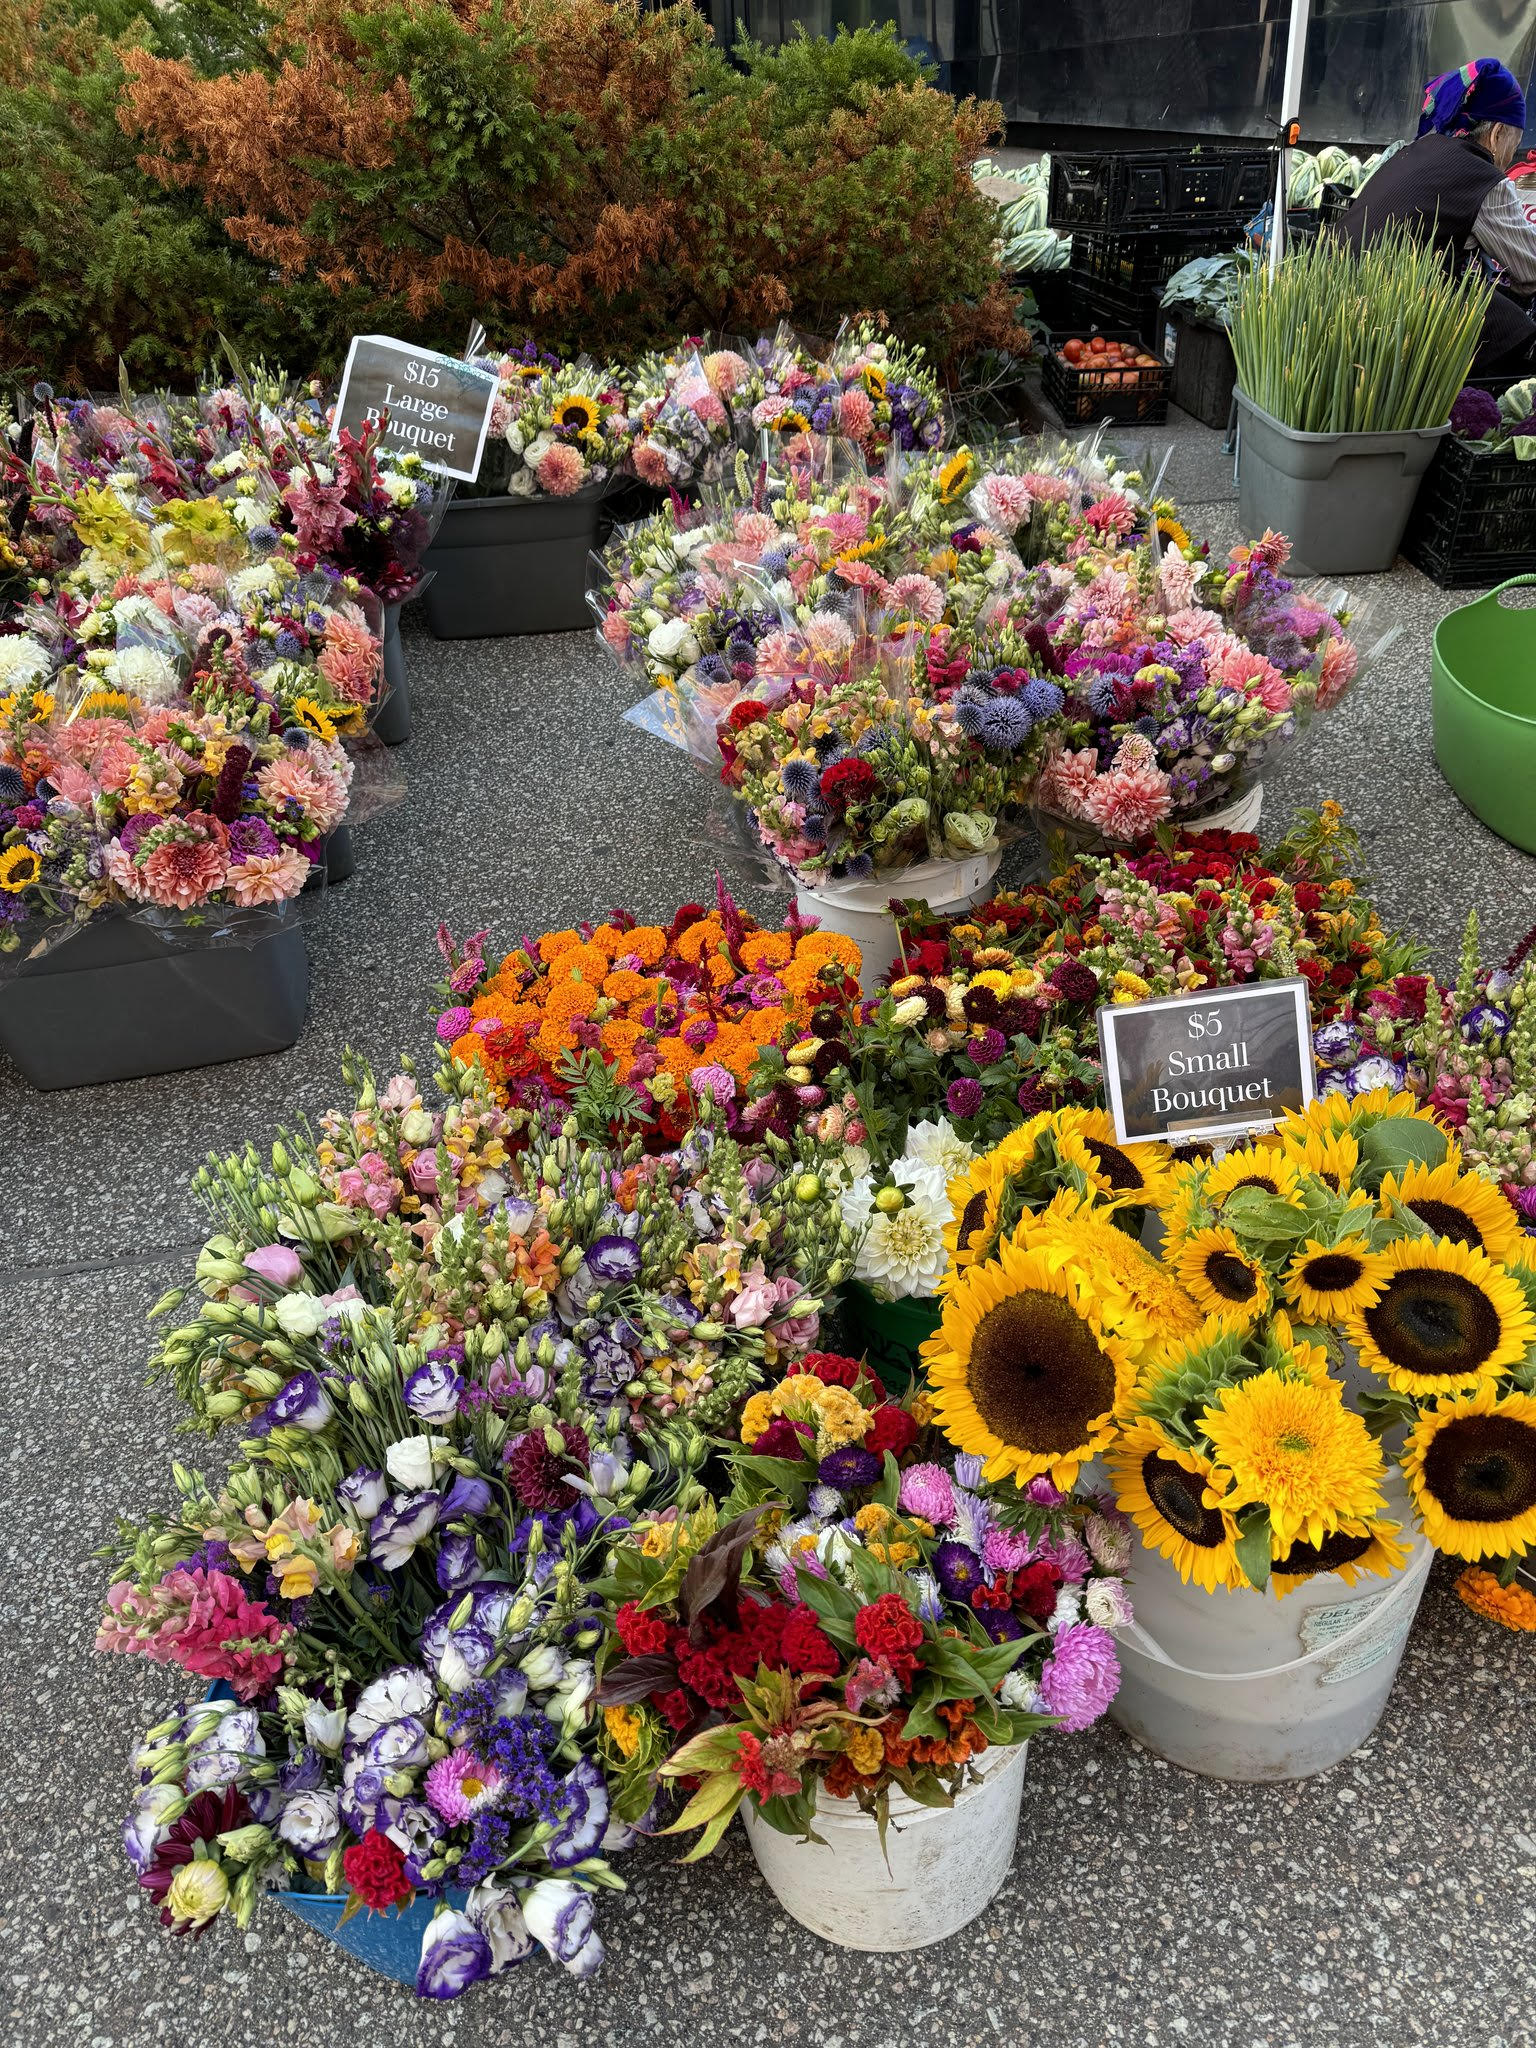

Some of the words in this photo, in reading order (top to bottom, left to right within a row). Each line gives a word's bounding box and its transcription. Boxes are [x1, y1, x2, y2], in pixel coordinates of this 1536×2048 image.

[403, 360, 442, 388] $15
[382, 383, 449, 422] Large
[1187, 1009, 1223, 1041] $5
[1168, 1041, 1251, 1077] Small
[1150, 1077, 1274, 1114] Bouquet
